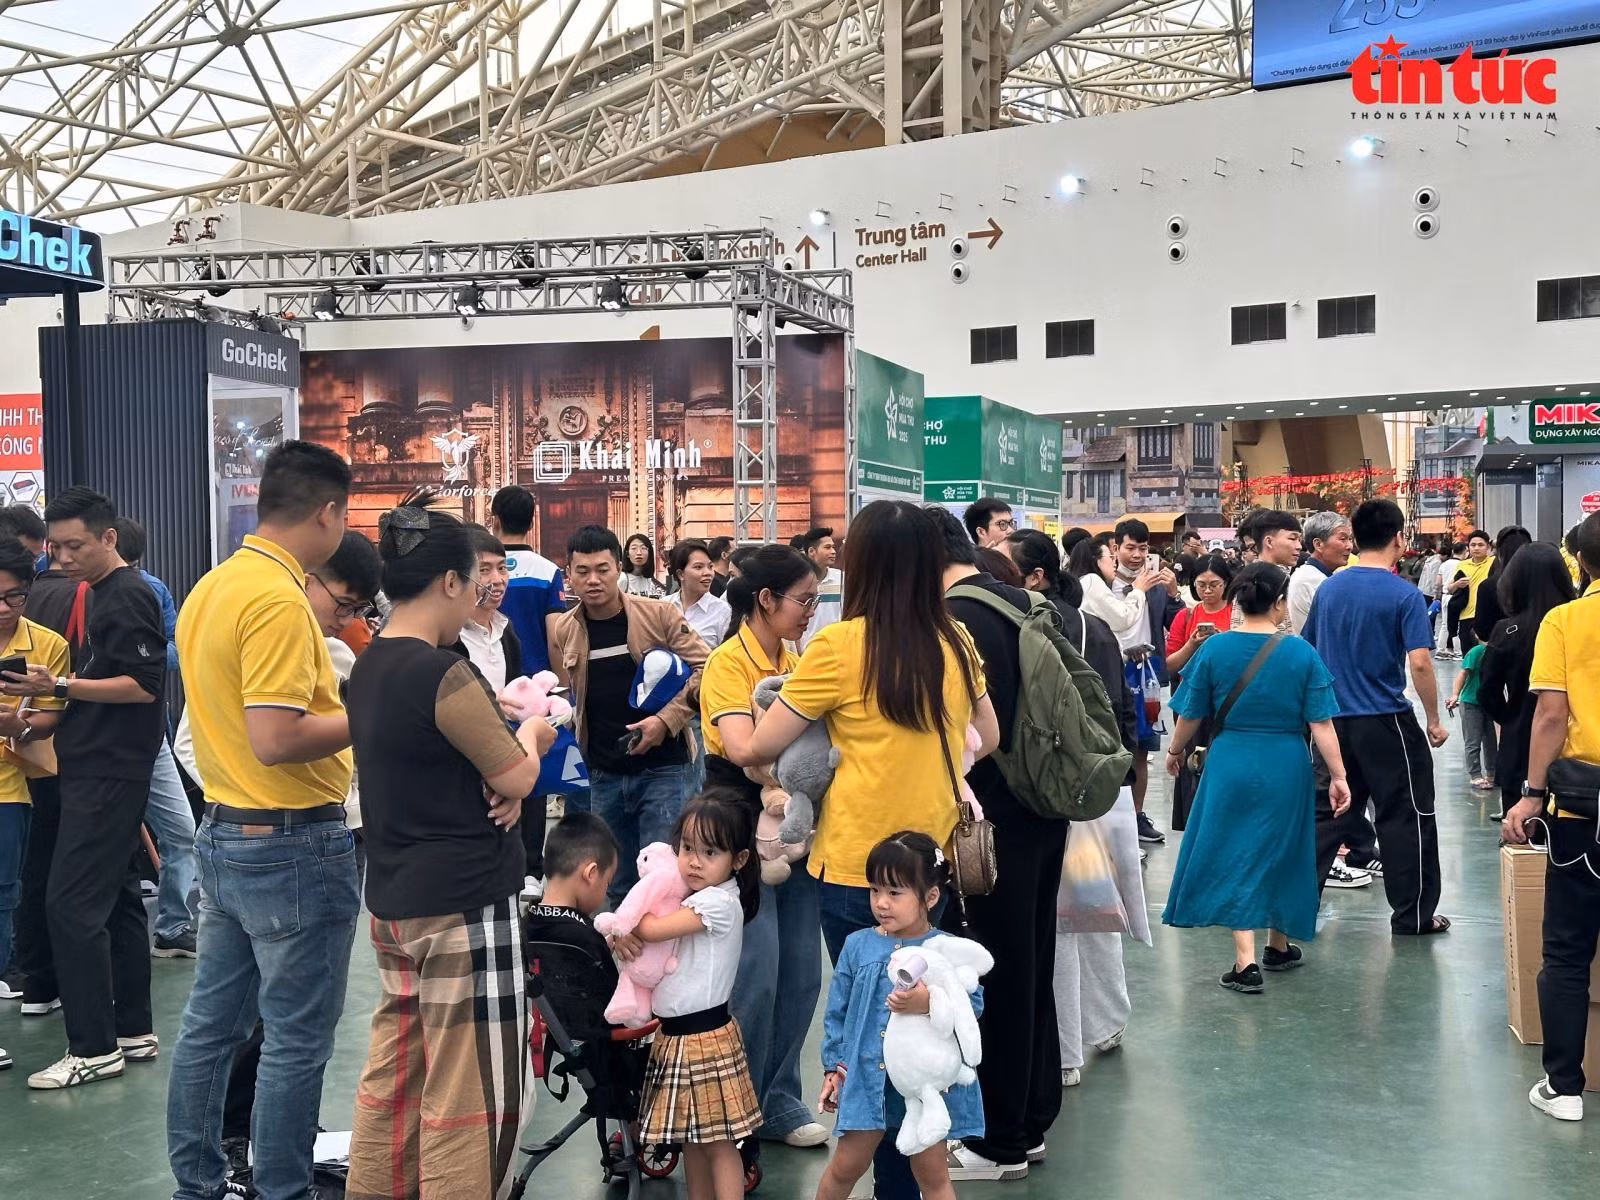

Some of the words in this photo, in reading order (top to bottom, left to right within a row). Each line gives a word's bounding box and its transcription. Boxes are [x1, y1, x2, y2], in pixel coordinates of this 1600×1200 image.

[1450, 42, 1465, 50] 1900
[1526, 29, 1550, 38] VinFast
[0, 209, 93, 277] Chek
[855, 227, 907, 247] Trung
[910, 221, 946, 240] tâm
[855, 253, 898, 268] Center
[900, 247, 927, 263] Hall
[222, 337, 288, 372] GoChek
[0, 408, 23, 426] HH
[1534, 402, 1600, 426] MIK
[923, 419, 944, 433] HỢ
[1535, 429, 1563, 439] DỰNG
[1564, 428, 1581, 437] XÂY
[0, 433, 33, 456] ÔNG
[923, 435, 948, 446] THU
[645, 438, 701, 469] Minh
[530, 904, 588, 926] GABBANA
